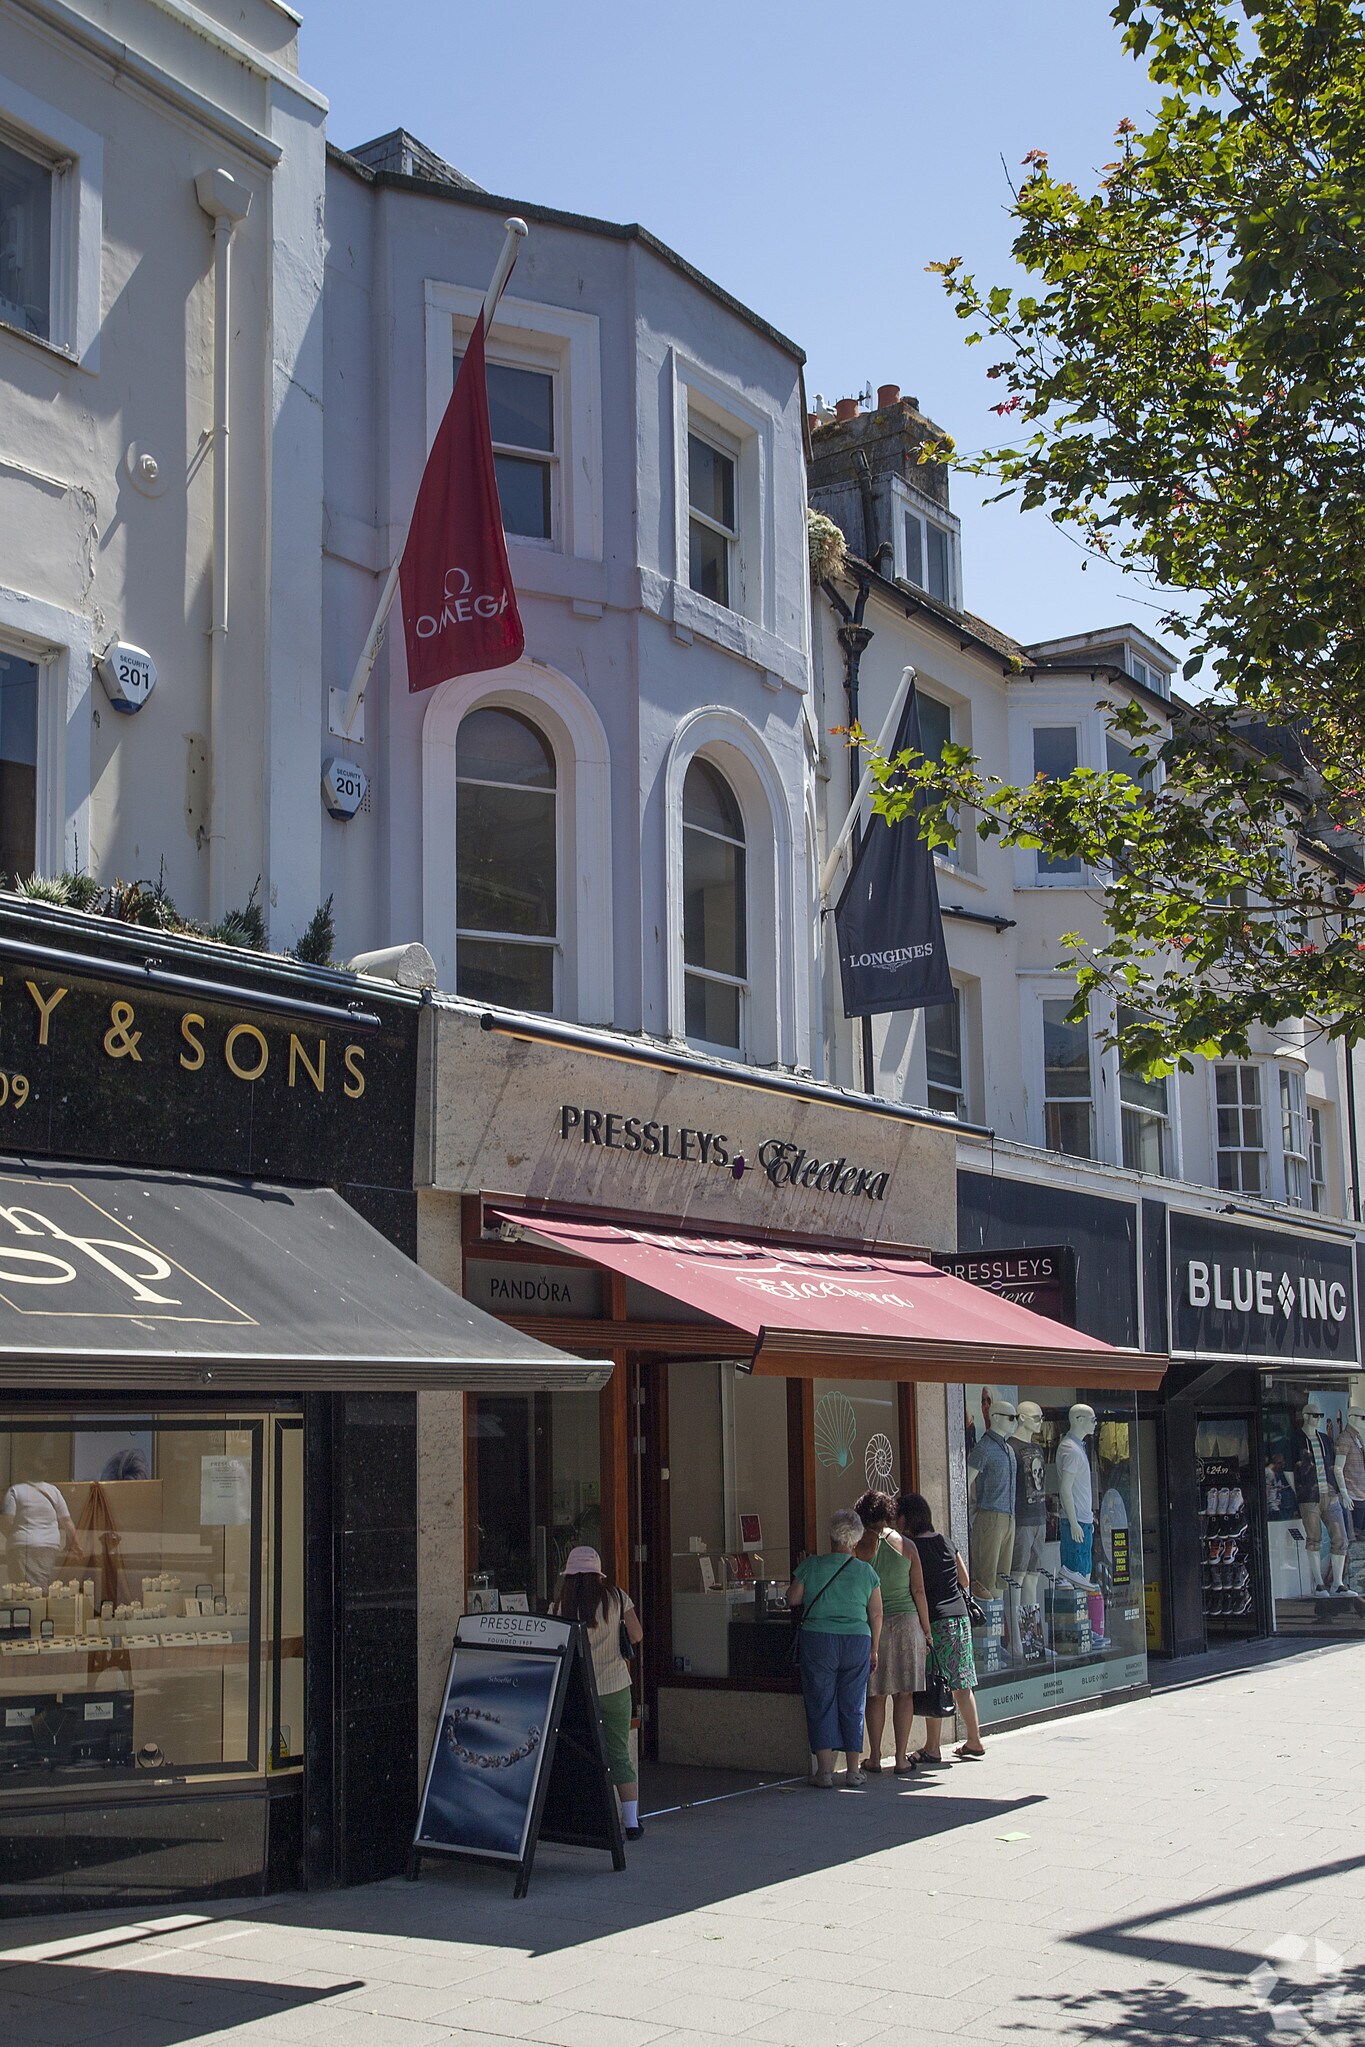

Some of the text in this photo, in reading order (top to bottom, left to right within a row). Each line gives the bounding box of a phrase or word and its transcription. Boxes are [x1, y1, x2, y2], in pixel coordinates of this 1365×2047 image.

[416, 587, 509, 638] OMEGA
[120, 655, 150, 670] SECURITY
[120, 664, 149, 690] 201
[336, 768, 361, 779] SECURITY
[336, 777, 361, 798] 201
[849, 942, 934, 968] LONGINES
[0, 976, 366, 1099] Y & SONS
[560, 1104, 890, 1200] PRESSLEYS Etcetera
[490, 1276, 572, 1302] PANDORA
[1188, 1260, 1347, 1322] BLUE INC
[480, 1616, 547, 1632] PRESSLEYS
[1043, 1680, 1063, 1689] BRANCHES
[1081, 1675, 1096, 1684] BLUE
[992, 1692, 1024, 1706] BLUE INC
[1042, 1687, 1064, 1698] NATIONWIDE
